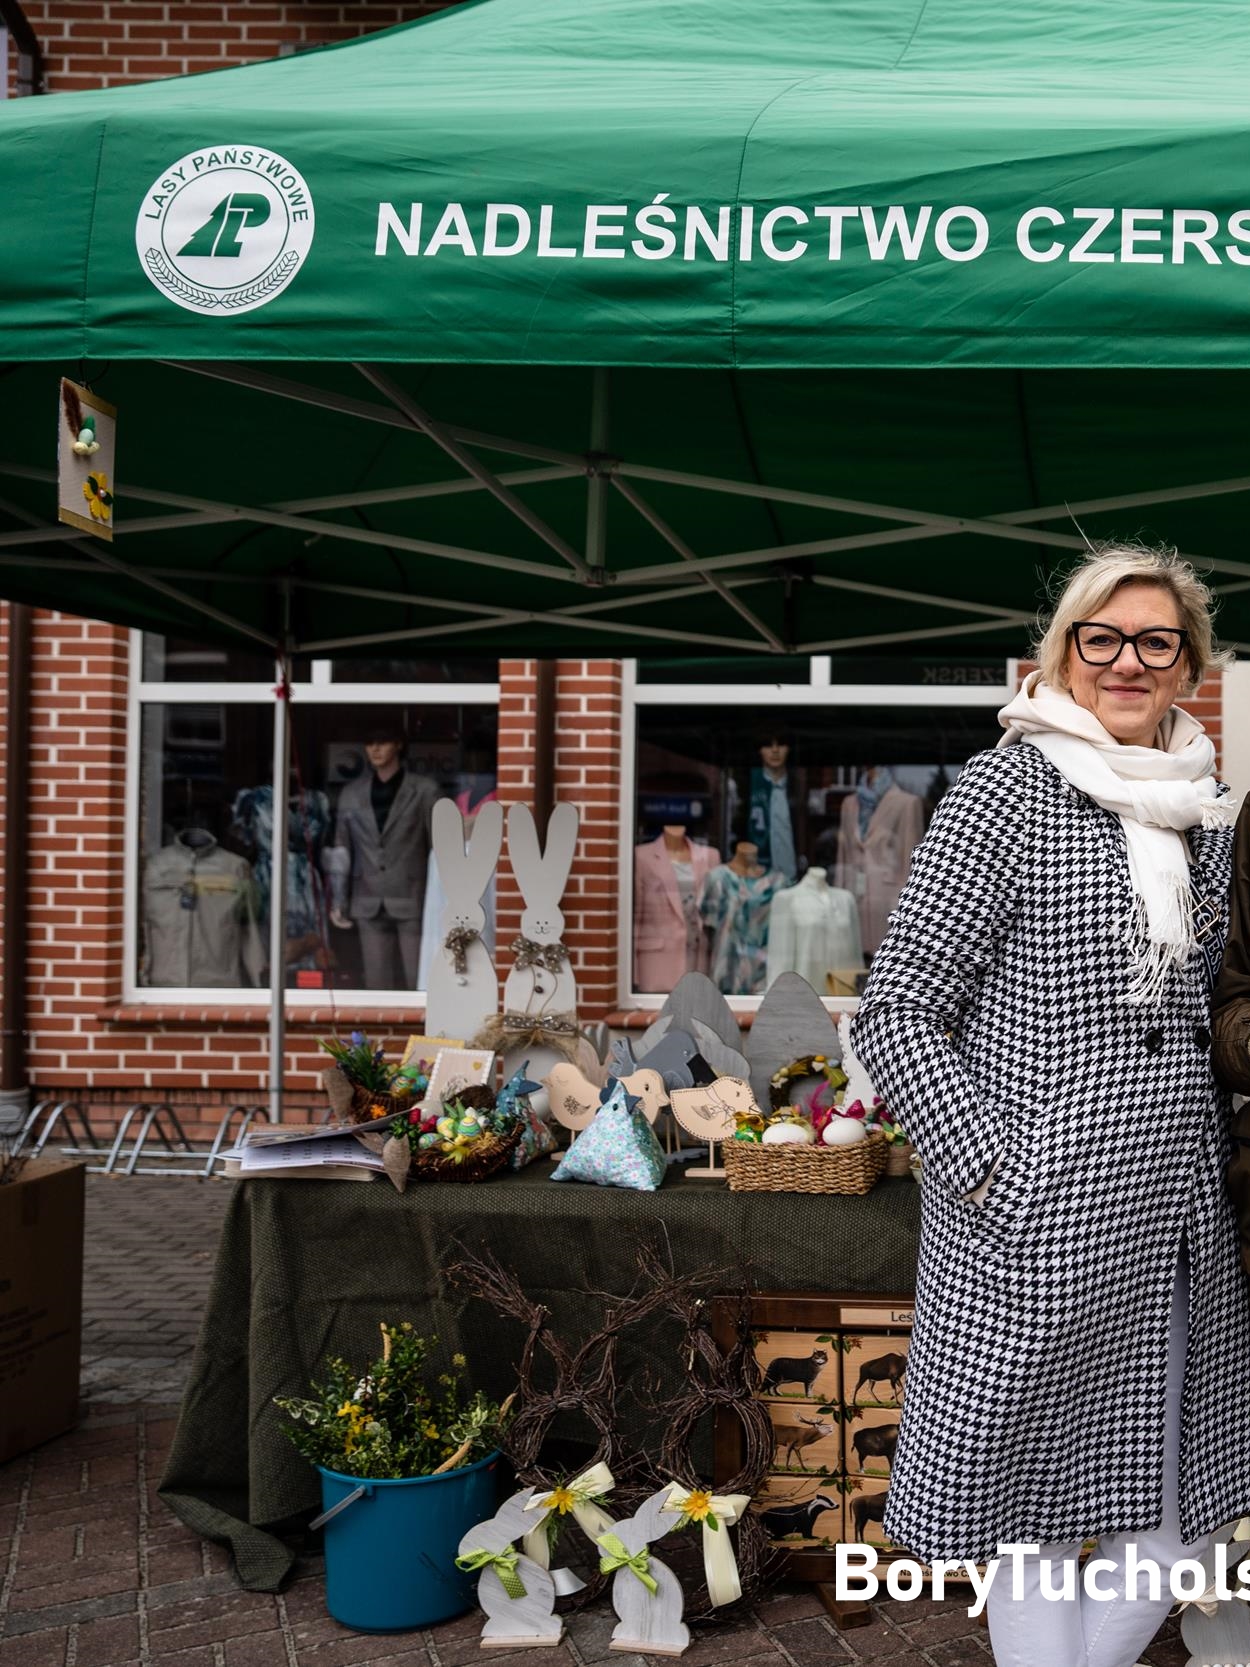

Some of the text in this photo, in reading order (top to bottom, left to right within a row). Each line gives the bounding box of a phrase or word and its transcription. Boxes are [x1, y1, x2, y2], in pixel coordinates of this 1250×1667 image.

[145, 147, 309, 223] LASY PAŃSTWOWE
[374, 192, 989, 262] NADLEŚNICTWO
